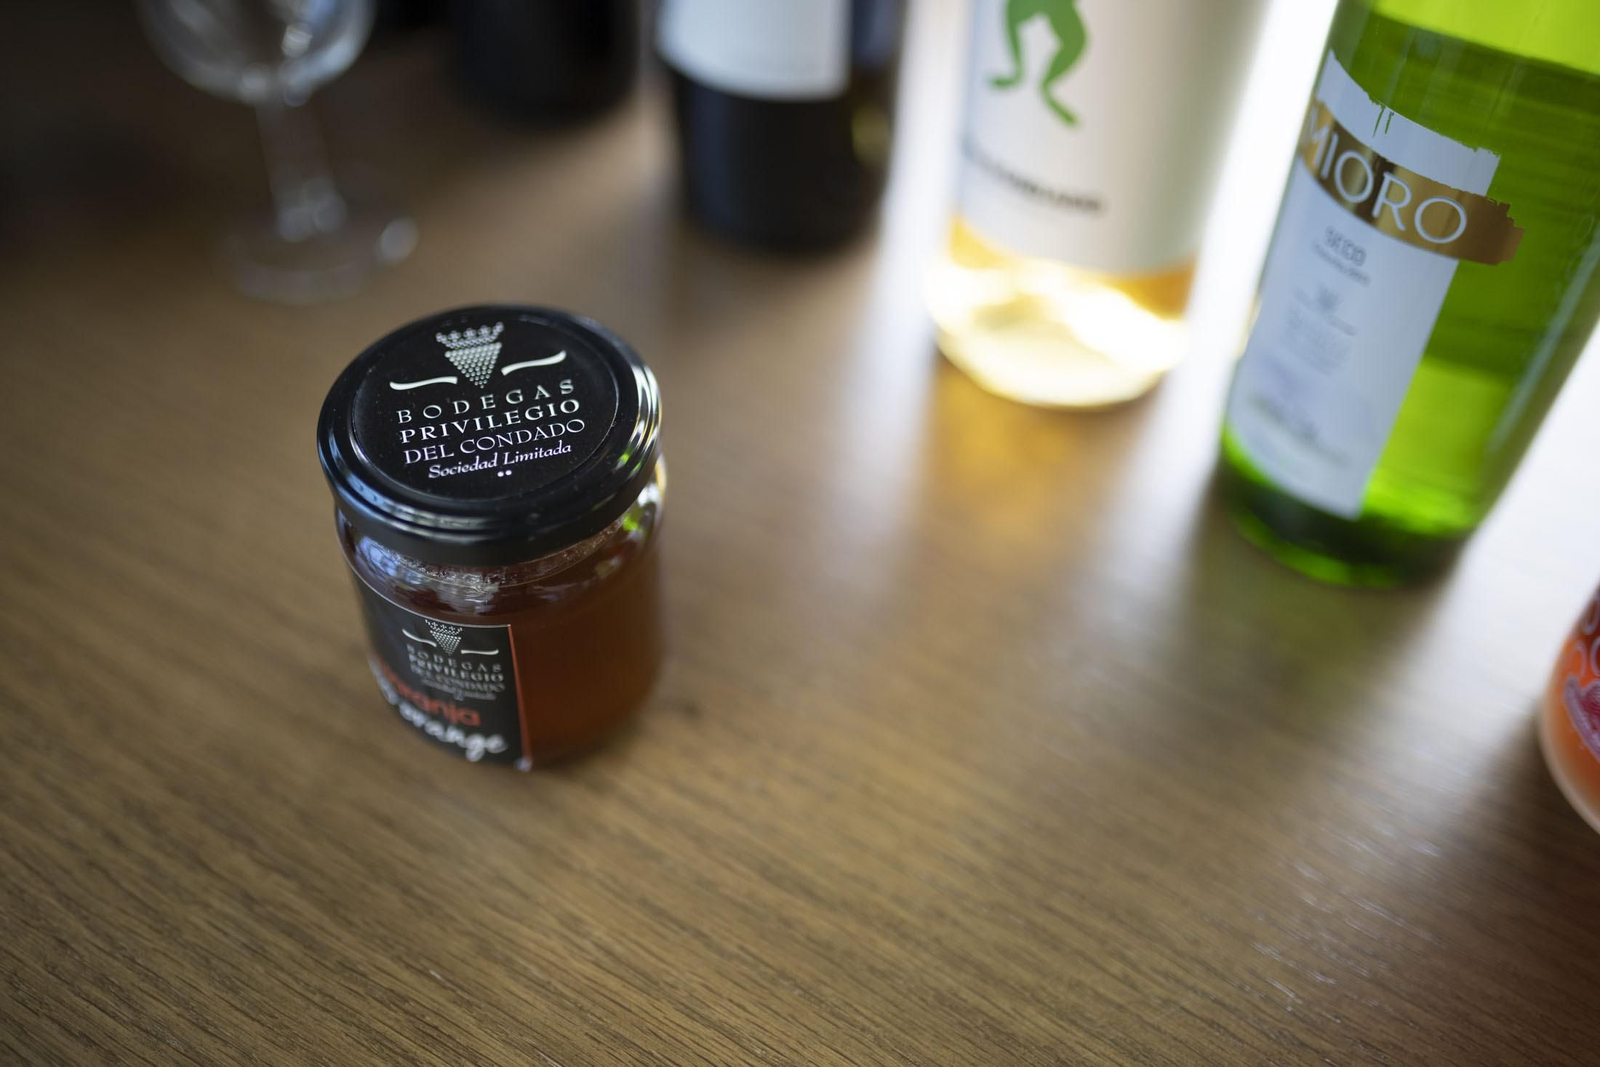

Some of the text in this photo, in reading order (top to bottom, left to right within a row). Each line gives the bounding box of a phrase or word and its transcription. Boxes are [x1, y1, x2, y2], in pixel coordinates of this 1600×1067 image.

[1301, 102, 1467, 244] MIORO
[396, 378, 574, 424] BODEGAS
[399, 399, 580, 443] PRIVILEGIO
[403, 418, 585, 464] DEL CONDADO
[428, 439, 572, 479] Sociedad Limitada
[406, 643, 502, 673] BODEGAS
[408, 653, 504, 683] PRIVILEGIO
